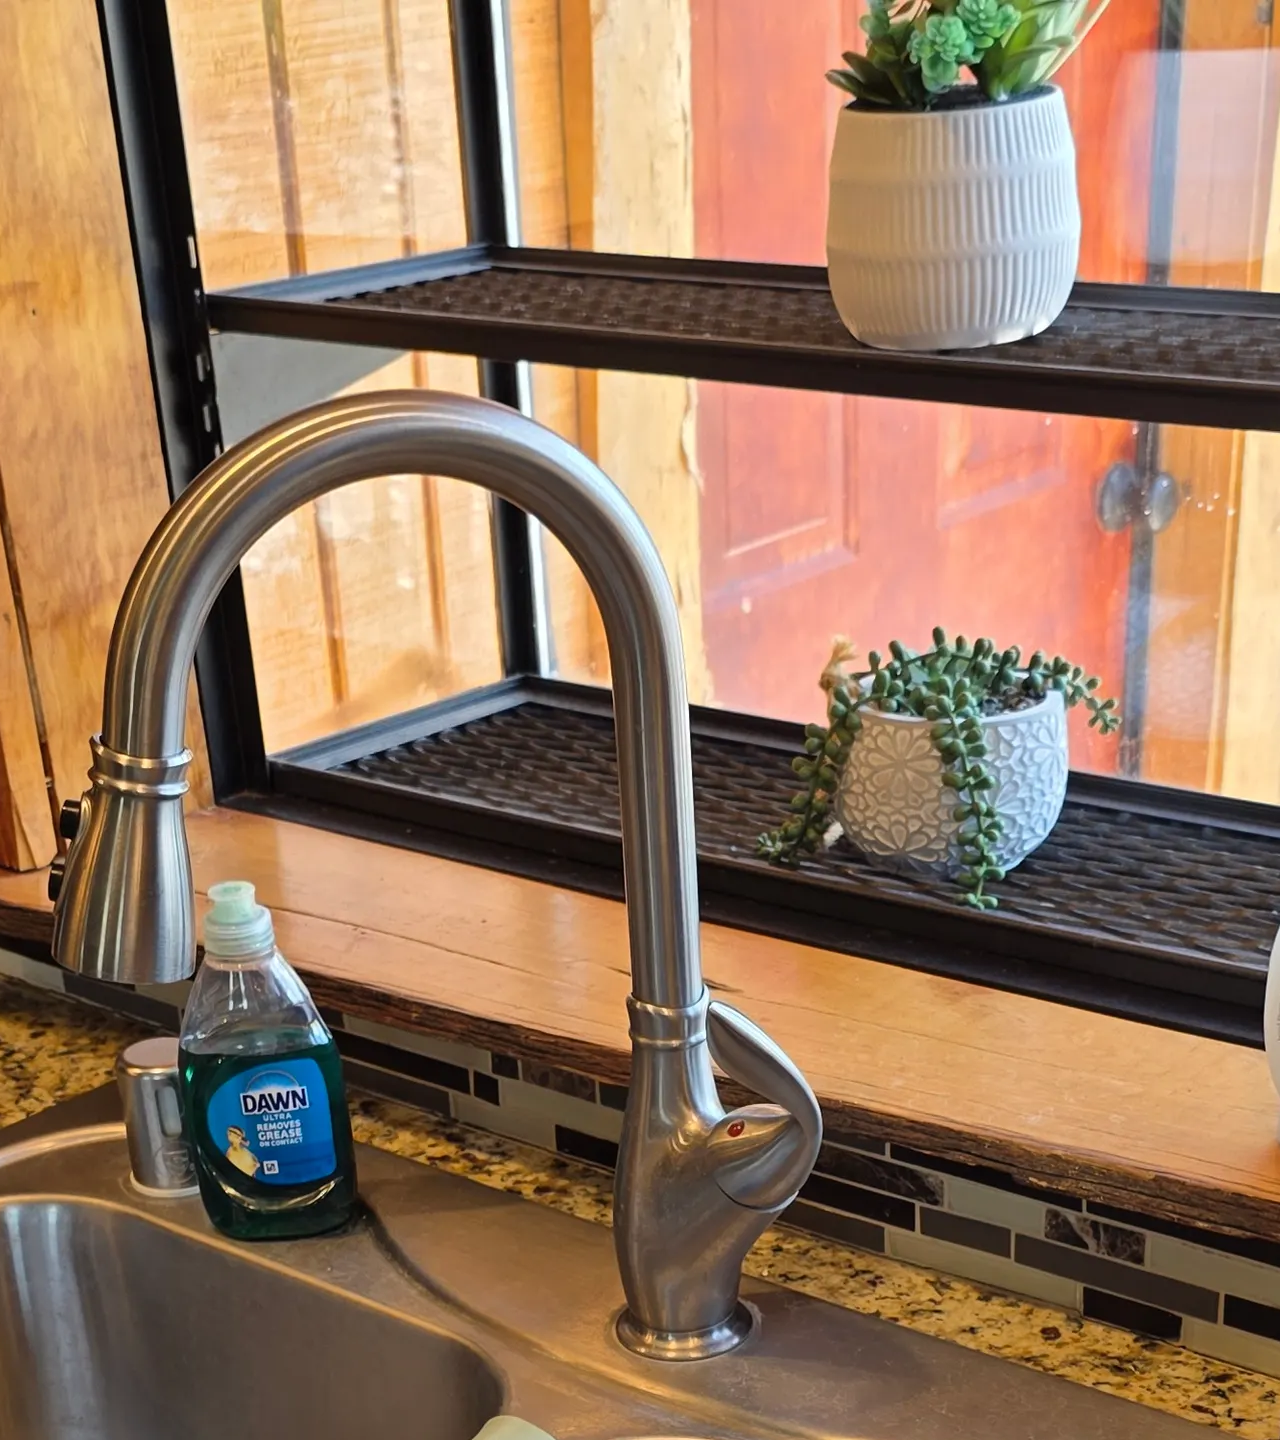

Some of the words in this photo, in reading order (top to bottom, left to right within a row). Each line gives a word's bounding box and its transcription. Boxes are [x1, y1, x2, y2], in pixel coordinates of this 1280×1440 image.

[241, 1087, 308, 1114] DAWN
[262, 1112, 293, 1122] ULTRA
[256, 1119, 302, 1132] REMOVES
[258, 1128, 303, 1141] GREASE
[259, 1140, 271, 1148] ON
[270, 1136, 304, 1147] CONTACT
